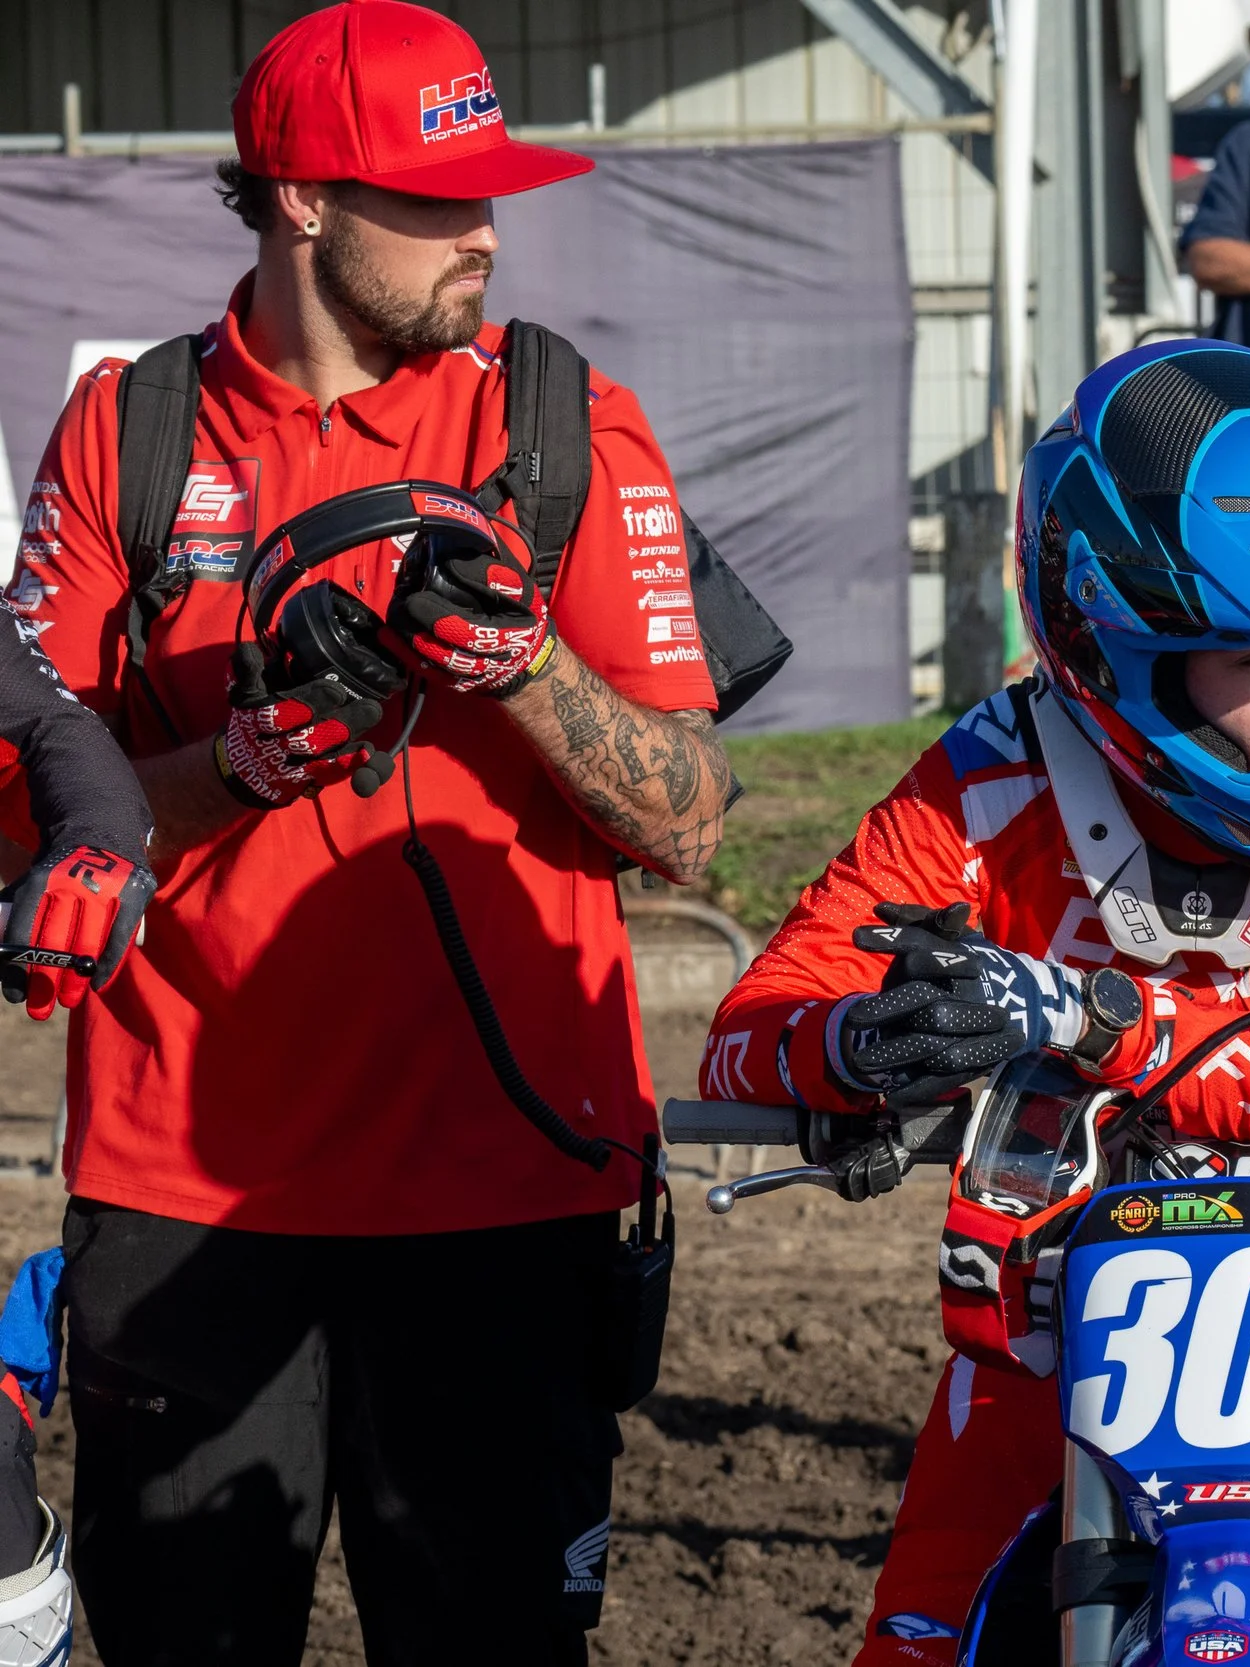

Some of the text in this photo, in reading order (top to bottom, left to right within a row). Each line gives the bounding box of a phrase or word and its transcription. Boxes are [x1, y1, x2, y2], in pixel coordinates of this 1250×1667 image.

[423, 122, 479, 145] Honda
[619, 486, 671, 499] HONDA
[622, 504, 677, 537] froth
[166, 540, 243, 570] HRC
[639, 545, 680, 557] DUNLOP
[195, 564, 235, 573] RACING
[1110, 1206, 1160, 1221] PENRITE
[1190, 1640, 1243, 1651] USA
